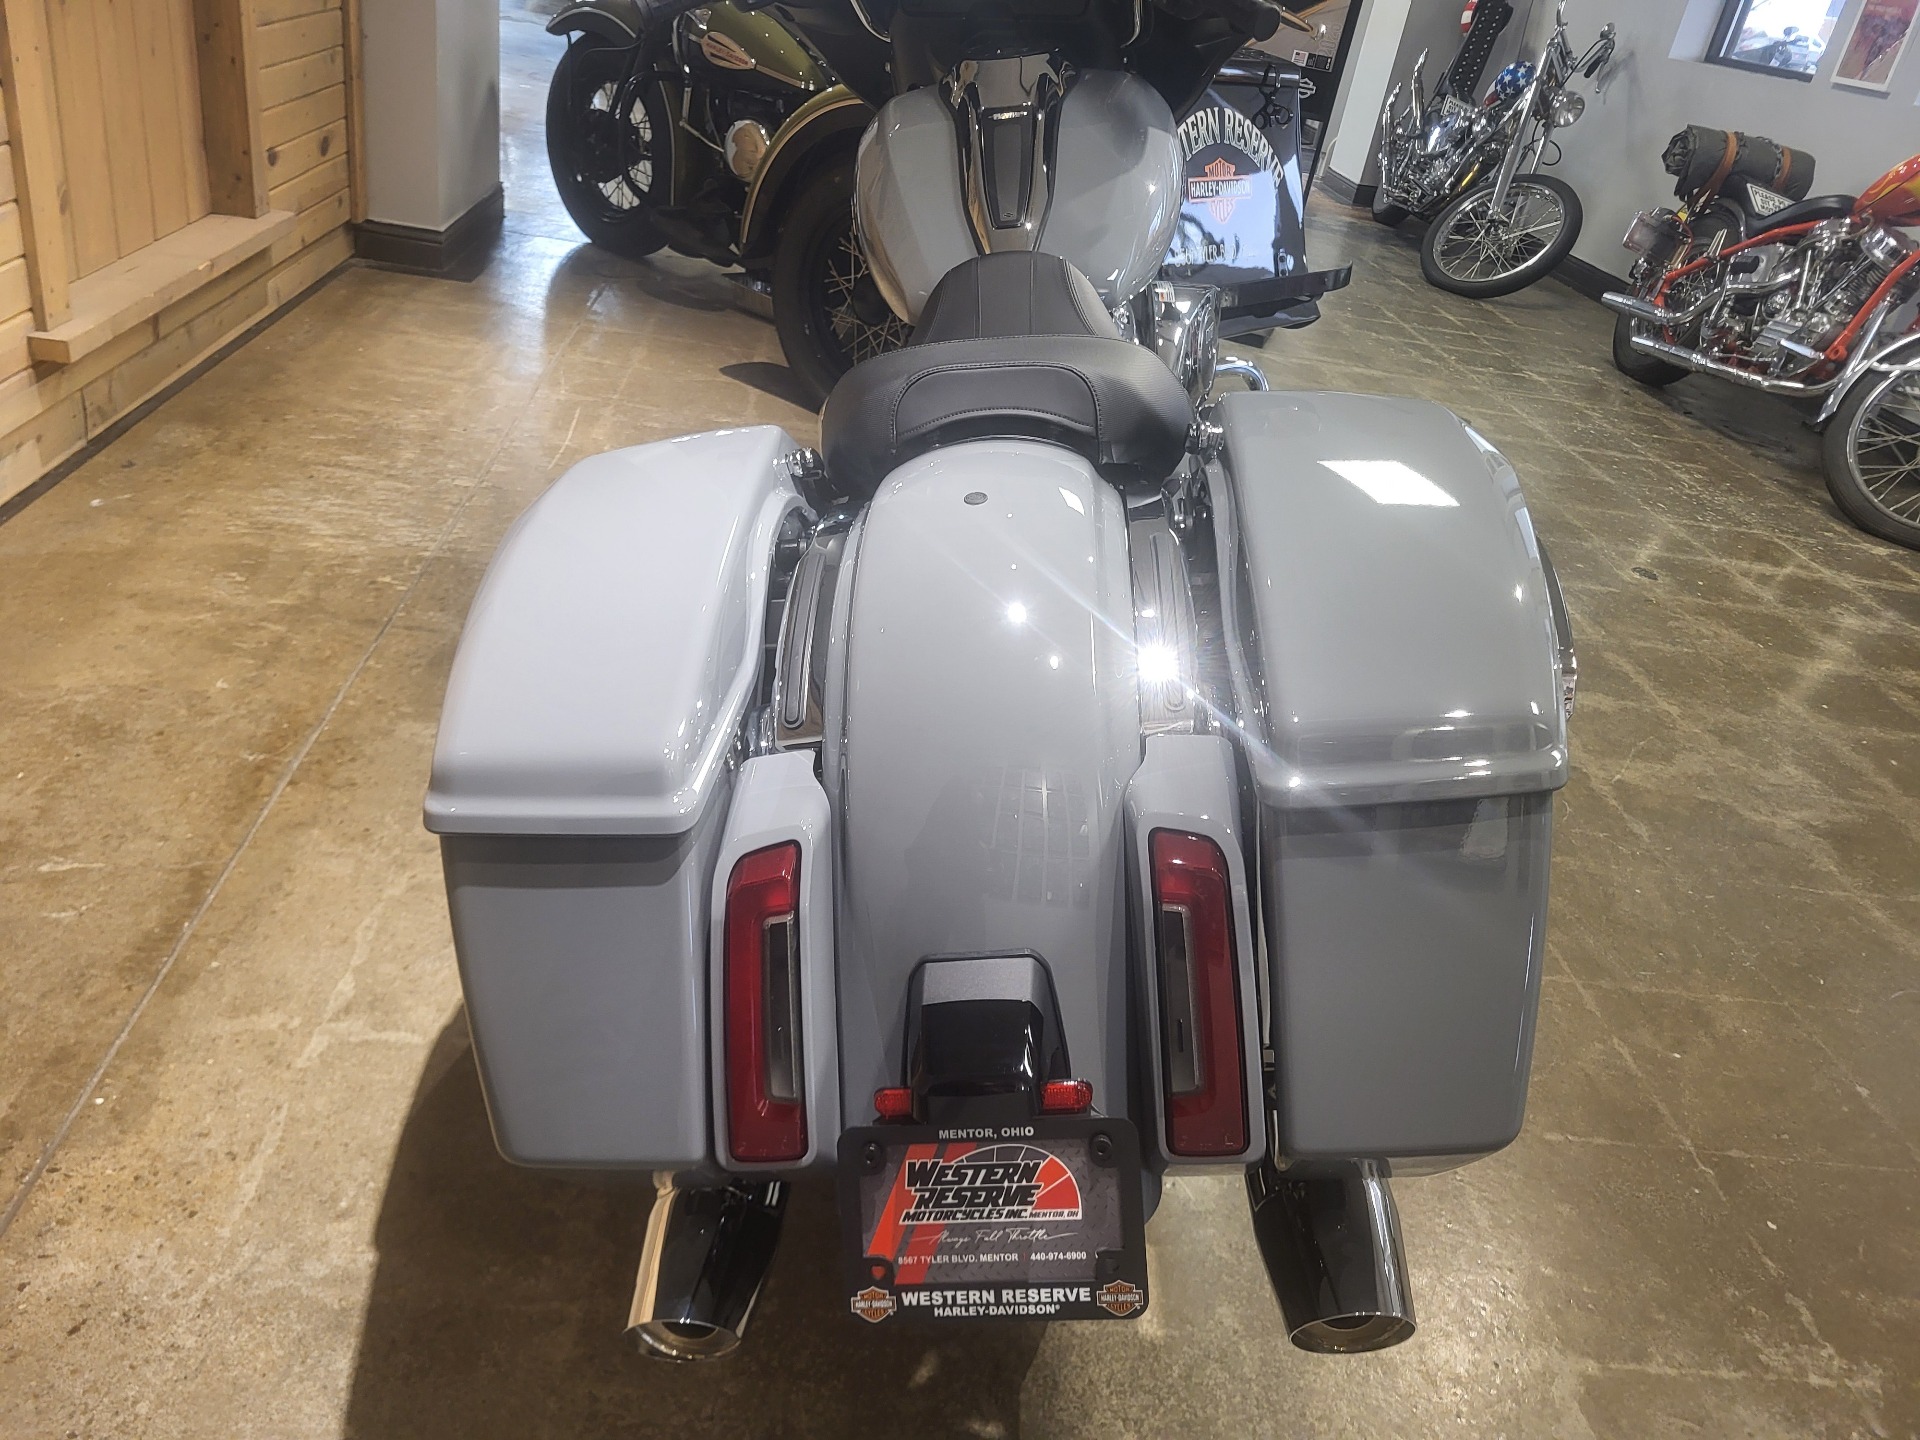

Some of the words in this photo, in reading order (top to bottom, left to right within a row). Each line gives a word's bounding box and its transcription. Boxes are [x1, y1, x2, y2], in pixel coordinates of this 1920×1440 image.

[1177, 106, 1221, 161] TERN
[1208, 161, 1232, 178] MOTOR
[939, 1128, 998, 1139] MENTOR,
[1001, 1126, 1035, 1137] OHIO
[906, 1159, 1043, 1188] WESTERN
[913, 1184, 1043, 1210] RESERVE
[901, 1208, 1004, 1223] MOTORCYCLES
[1005, 1208, 1028, 1219] INC.
[1029, 1211, 1066, 1219] MENTOR,
[920, 1254, 950, 1265] TYLER
[951, 1254, 978, 1264] BLVD.
[979, 1253, 1019, 1262] MENTOR
[901, 1289, 996, 1307] WESTERN
[1001, 1287, 1091, 1304] RESERVE
